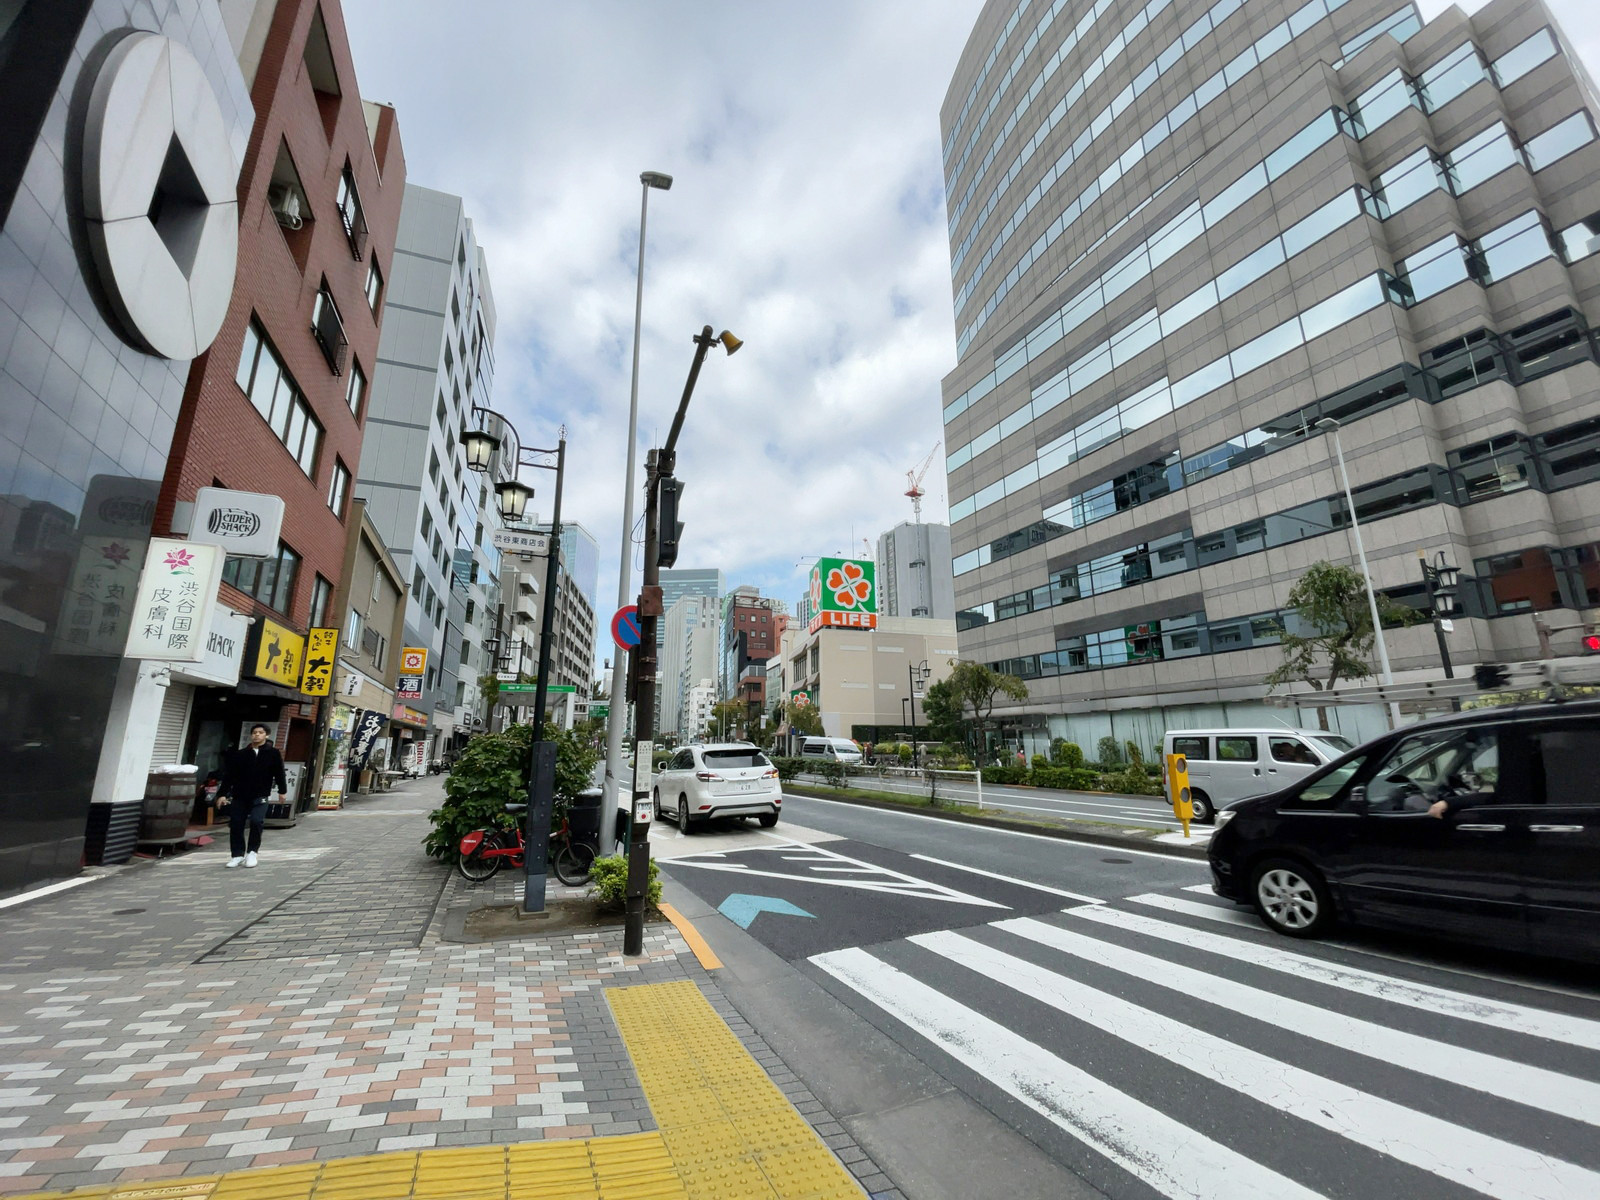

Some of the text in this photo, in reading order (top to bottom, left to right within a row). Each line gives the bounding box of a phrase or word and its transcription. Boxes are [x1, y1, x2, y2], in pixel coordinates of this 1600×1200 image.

[223, 513, 252, 524] CIDER
[221, 522, 251, 532] SHACK
[494, 534, 545, 548] 渋谷東商店会
[142, 588, 173, 640] 皮膚科
[167, 581, 199, 650] 渋谷国際
[830, 612, 871, 626] LIFE
[402, 678, 419, 692] 酒
[398, 691, 420, 699] たばこ
[417, 741, 425, 765] KIRIN
